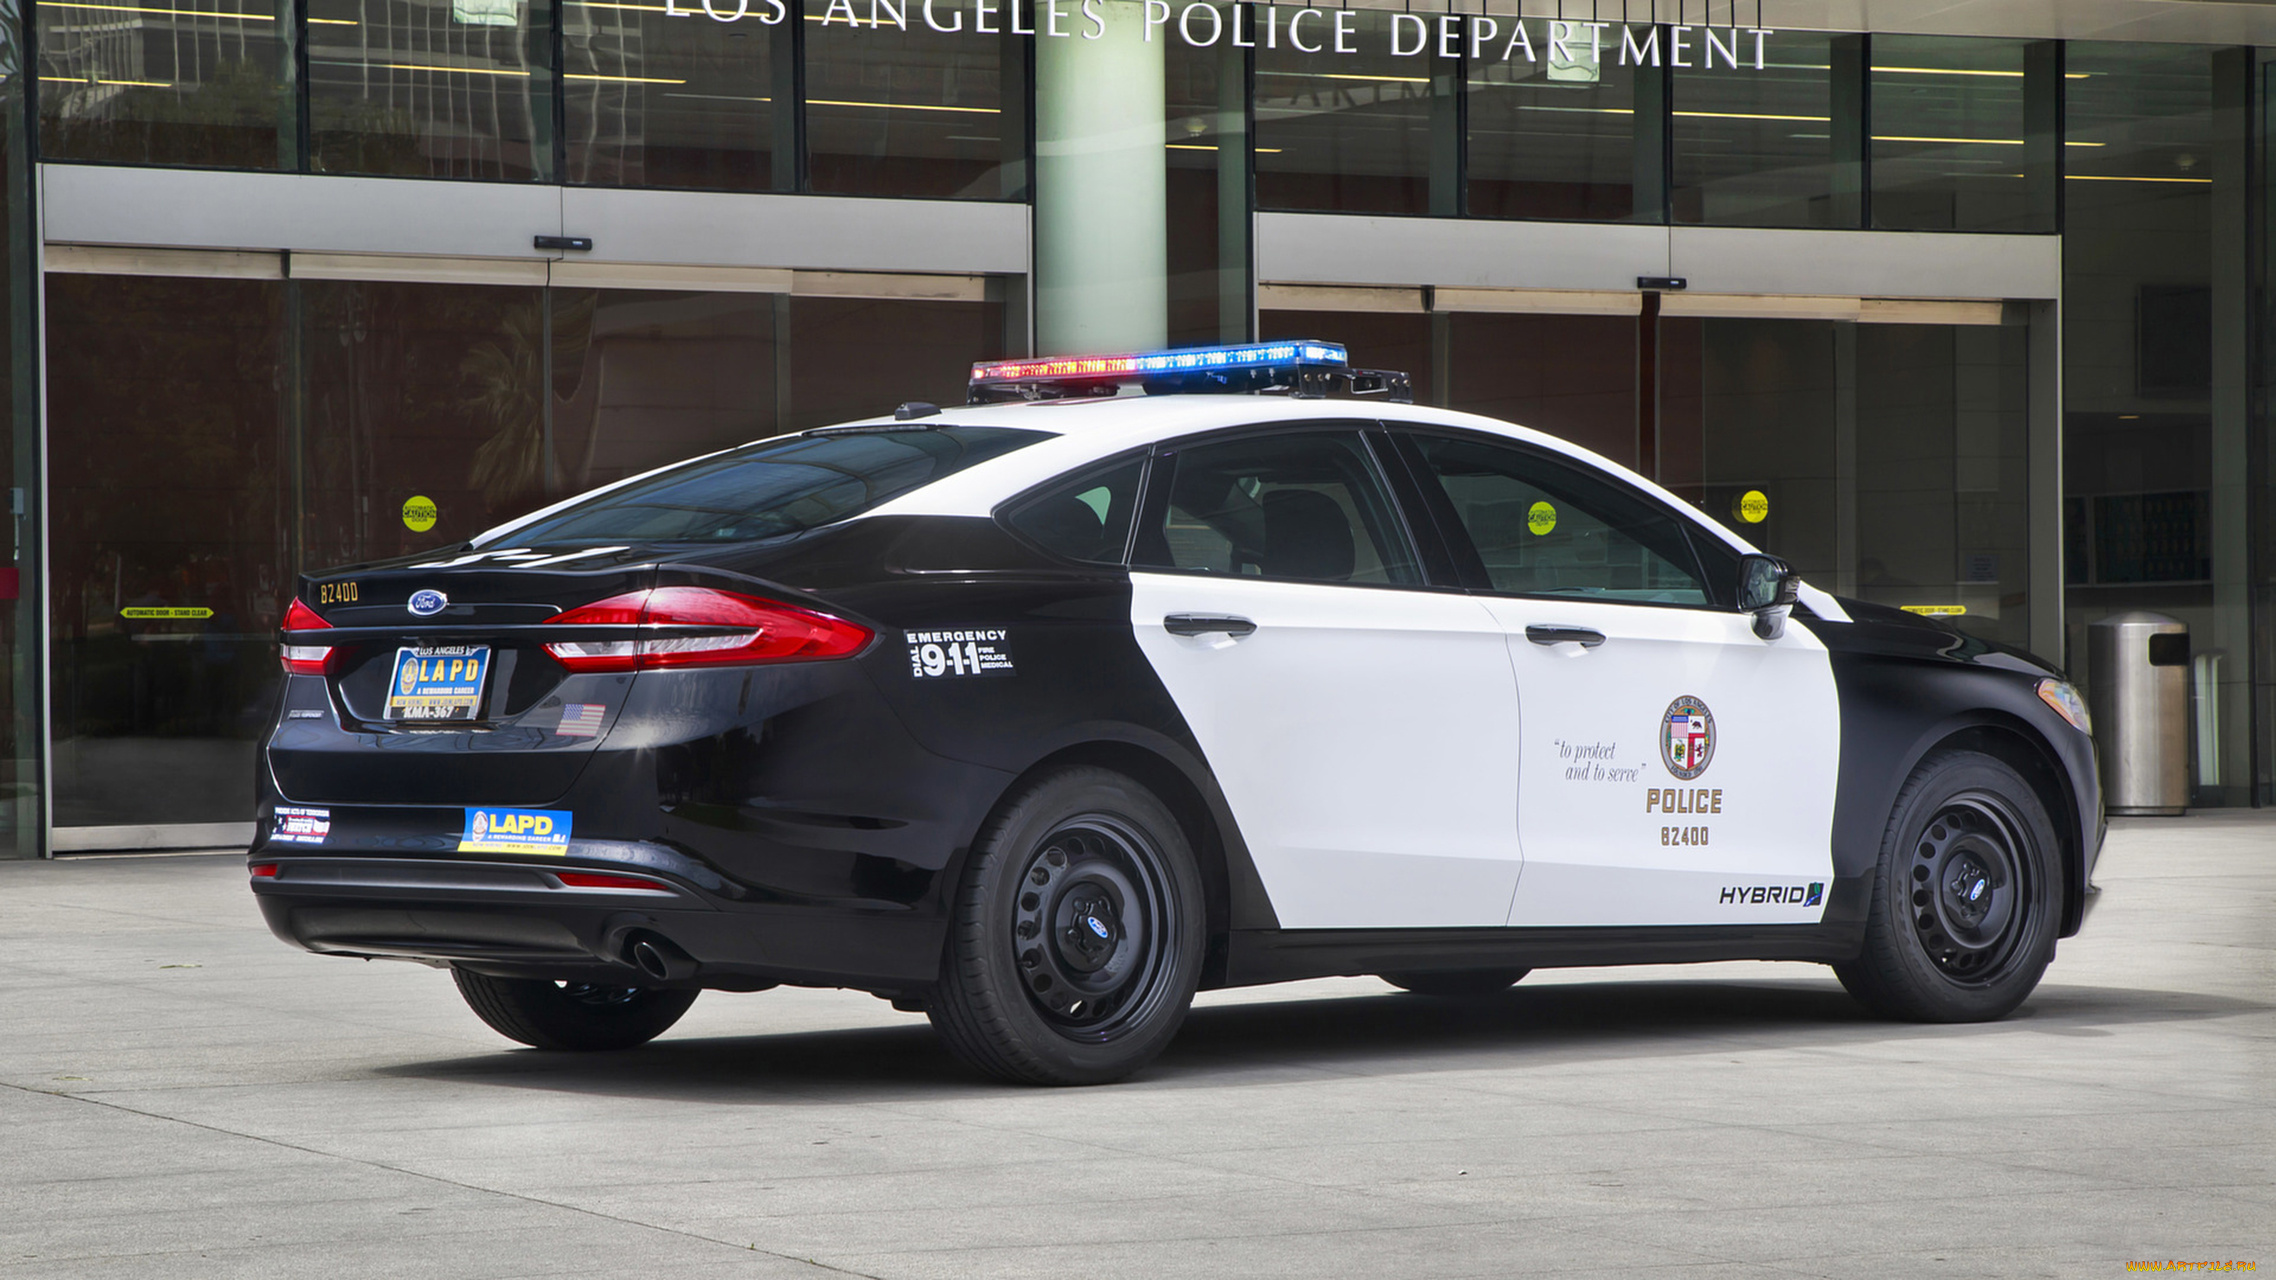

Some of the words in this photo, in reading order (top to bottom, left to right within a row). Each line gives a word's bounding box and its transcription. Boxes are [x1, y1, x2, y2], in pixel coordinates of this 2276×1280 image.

[666, 0, 787, 25] LOS
[822, 0, 1106, 40] ANGELES
[1144, 0, 1357, 53] POLICE
[1391, 14, 1774, 70] DEPARTMENT
[320, 582, 358, 604] 82400
[906, 630, 1007, 644] EMERGENCY
[420, 647, 433, 655] LOS
[434, 646, 465, 655] ANGELES
[910, 645, 923, 678] DIAL
[981, 661, 1013, 669] MEDICAL
[403, 706, 455, 719] KMA-367
[1574, 741, 1616, 763] protect
[1565, 761, 1591, 781] and
[1593, 763, 1605, 781] to
[1646, 788, 1723, 814] POLICE
[489, 814, 553, 835] LAPD
[1661, 826, 1709, 846] 82400
[1719, 886, 1805, 904] HYBRID
